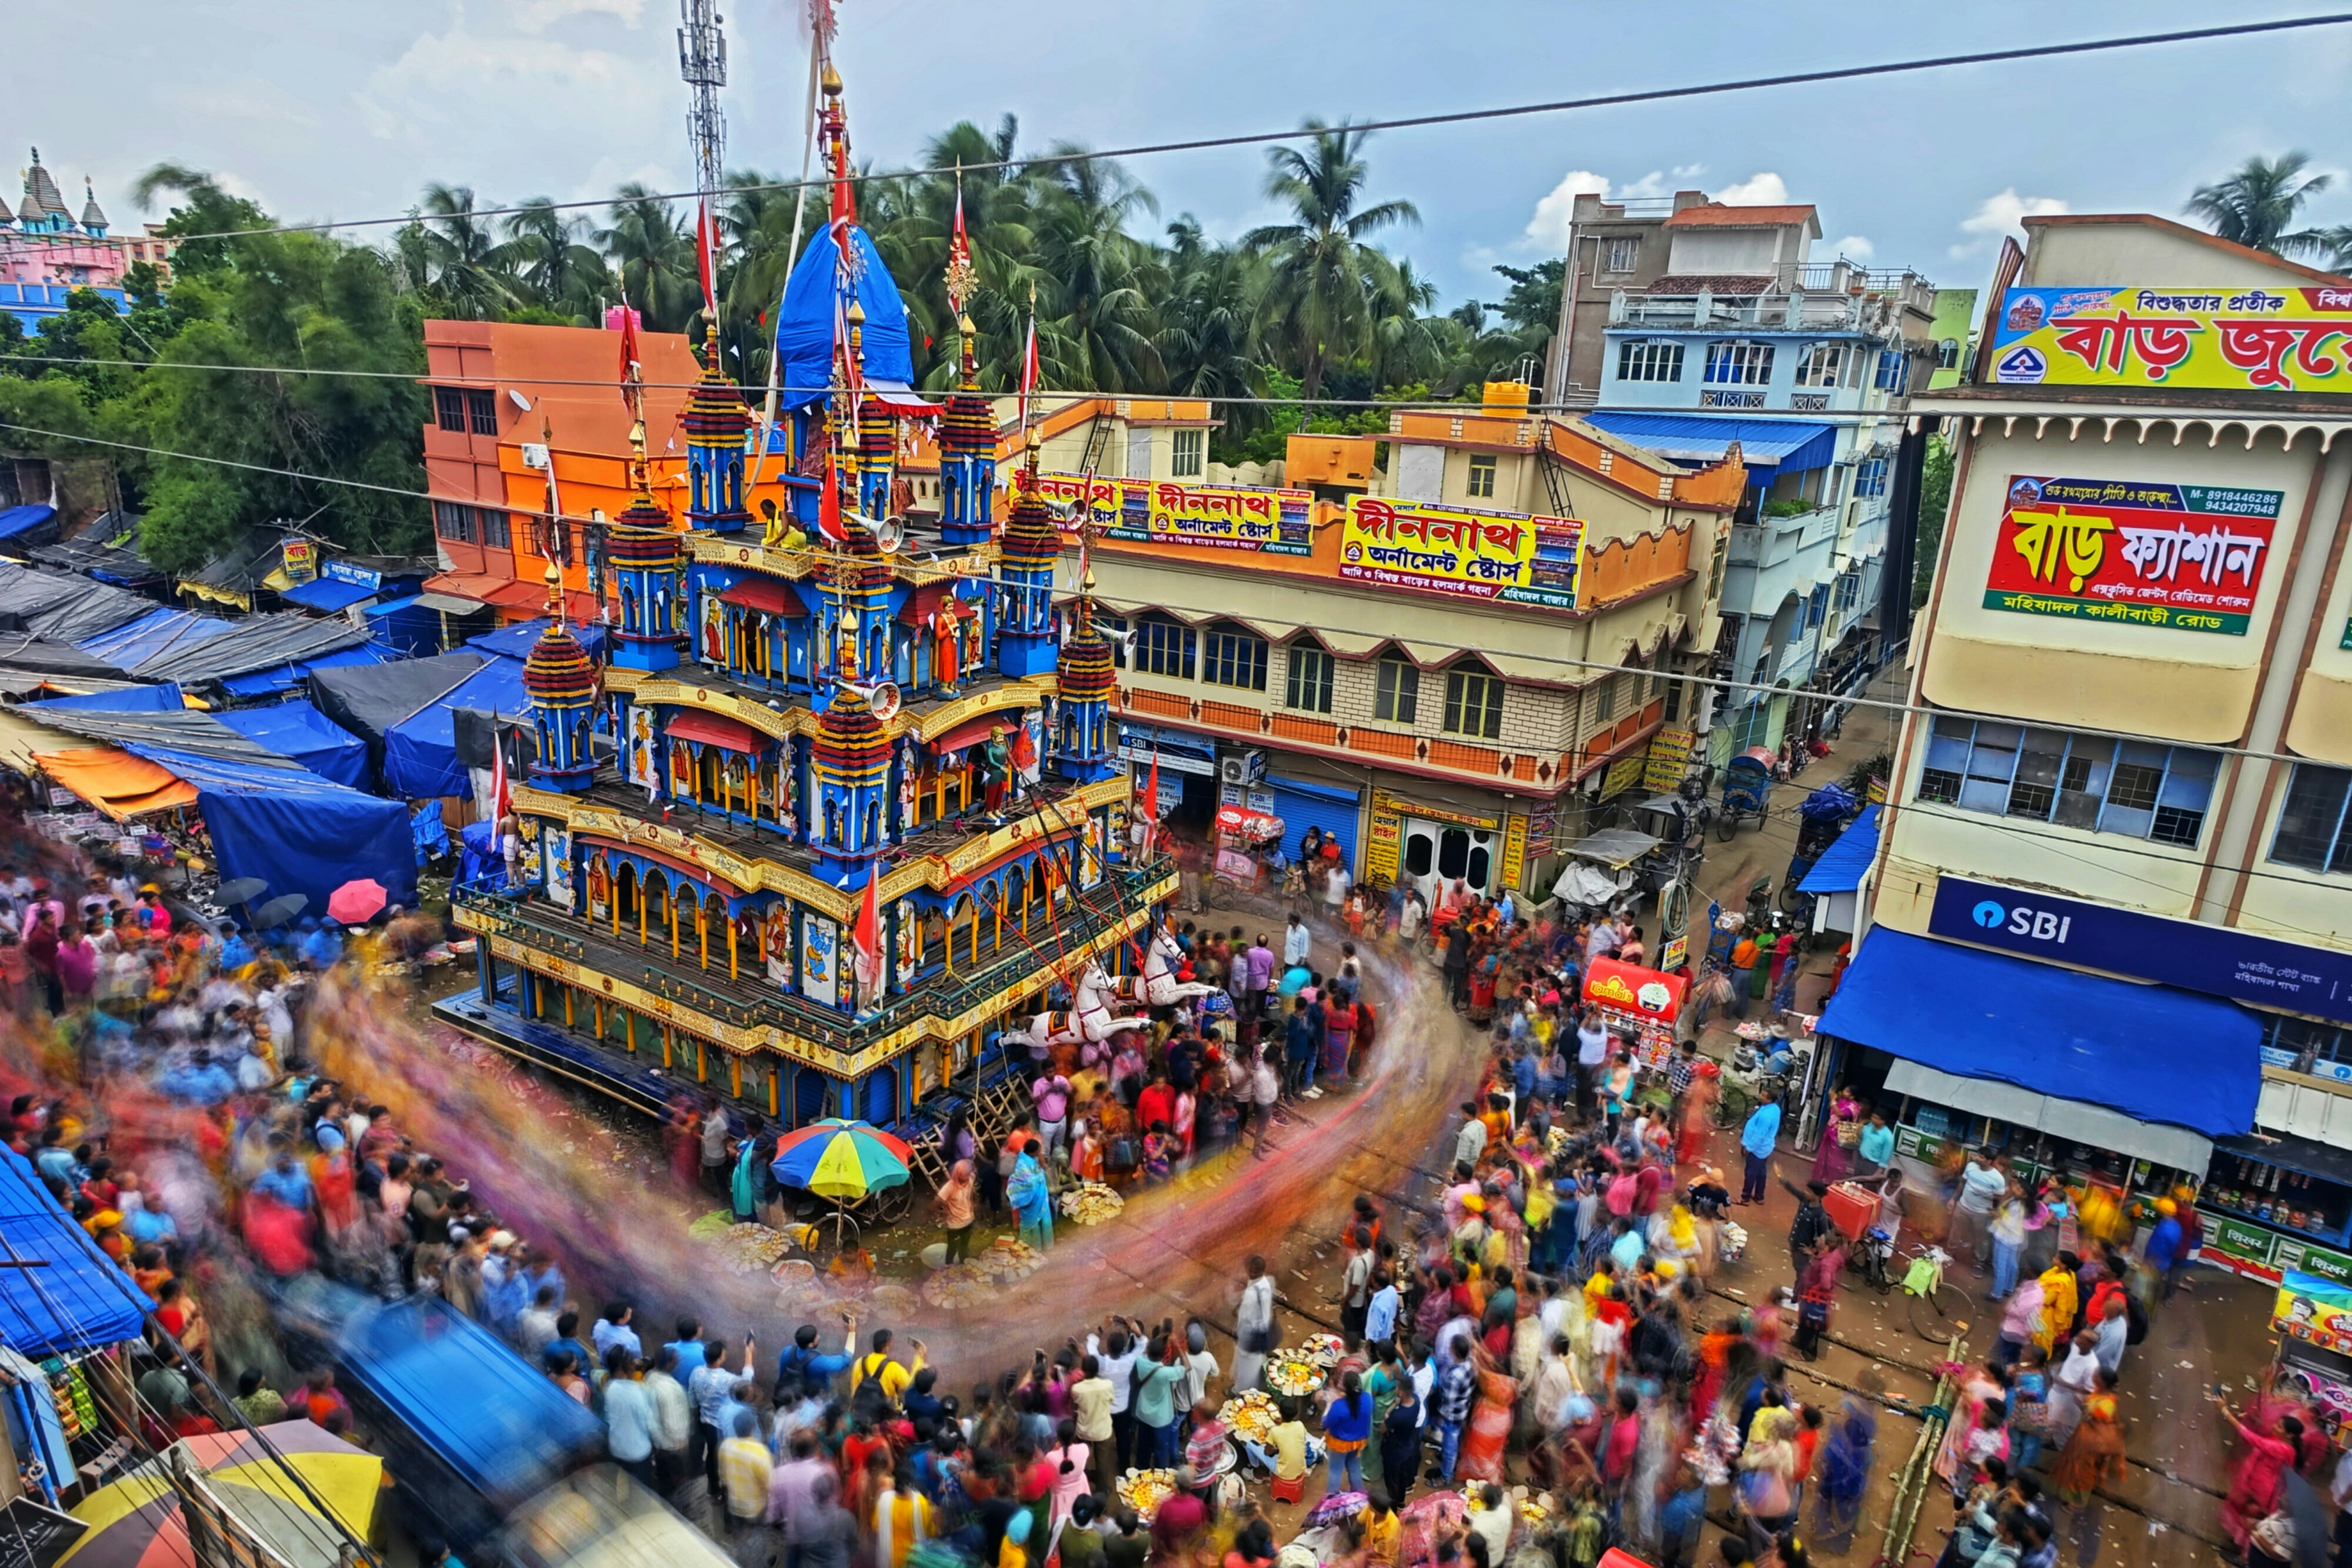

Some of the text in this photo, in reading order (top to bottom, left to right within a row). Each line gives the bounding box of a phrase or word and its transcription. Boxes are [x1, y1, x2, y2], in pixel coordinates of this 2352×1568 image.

[2136, 291, 2286, 313] বিশুদ্ধতার প্রতীক
[2317, 289, 2352, 308] বিশ্ব
[2048, 309, 2204, 381] বাড়
[1154, 483, 1274, 521] দীননাথ
[2046, 485, 2061, 496] শুভ
[2127, 491, 2135, 500] ও
[2190, 489, 2278, 504] M- 8918446286
[2205, 501, 2275, 515] 9434207948
[1351, 498, 1527, 557] দীননাথ
[1216, 538, 1238, 549] হলমার্ক
[1240, 541, 1256, 550] গহনা
[1265, 544, 1289, 553] মহিষাদল
[1291, 547, 1307, 555] বাজার
[2011, 505, 2267, 593] বাড় ফ্যাশান
[1367, 546, 1459, 572] অর্নামেন্ট
[1342, 567, 1362, 577] আদি
[1374, 570, 1399, 584] বিশ্বস্ত
[1402, 574, 1430, 588] বাড়ের
[1432, 578, 1465, 592] হলমার্ক
[1467, 584, 1492, 596] গহনা
[1503, 588, 1540, 603] মহিষাদল
[1543, 595, 1568, 606] বাজার
[2170, 589, 2214, 605] রেডিমেড
[2216, 595, 2251, 608] শোরুম
[2002, 595, 2224, 630] মহিষাদল কালীবাড়ী রোড
[1131, 738, 1146, 749] SBI
[1257, 753, 1265, 762] SBI
[1250, 765, 1265, 782] ATM
[1165, 792, 1181, 801] Point
[2007, 906, 2072, 944] SBI
[2234, 971, 2301, 992] মহিষাদল শাখা
[2237, 961, 2322, 984] ভারতীয় স্টেট ব্যাঙ্ক
[1590, 980, 1634, 1004] Kamal's
[2227, 1229, 2262, 1248] शिखर
[2311, 1257, 2349, 1277] शिखर
